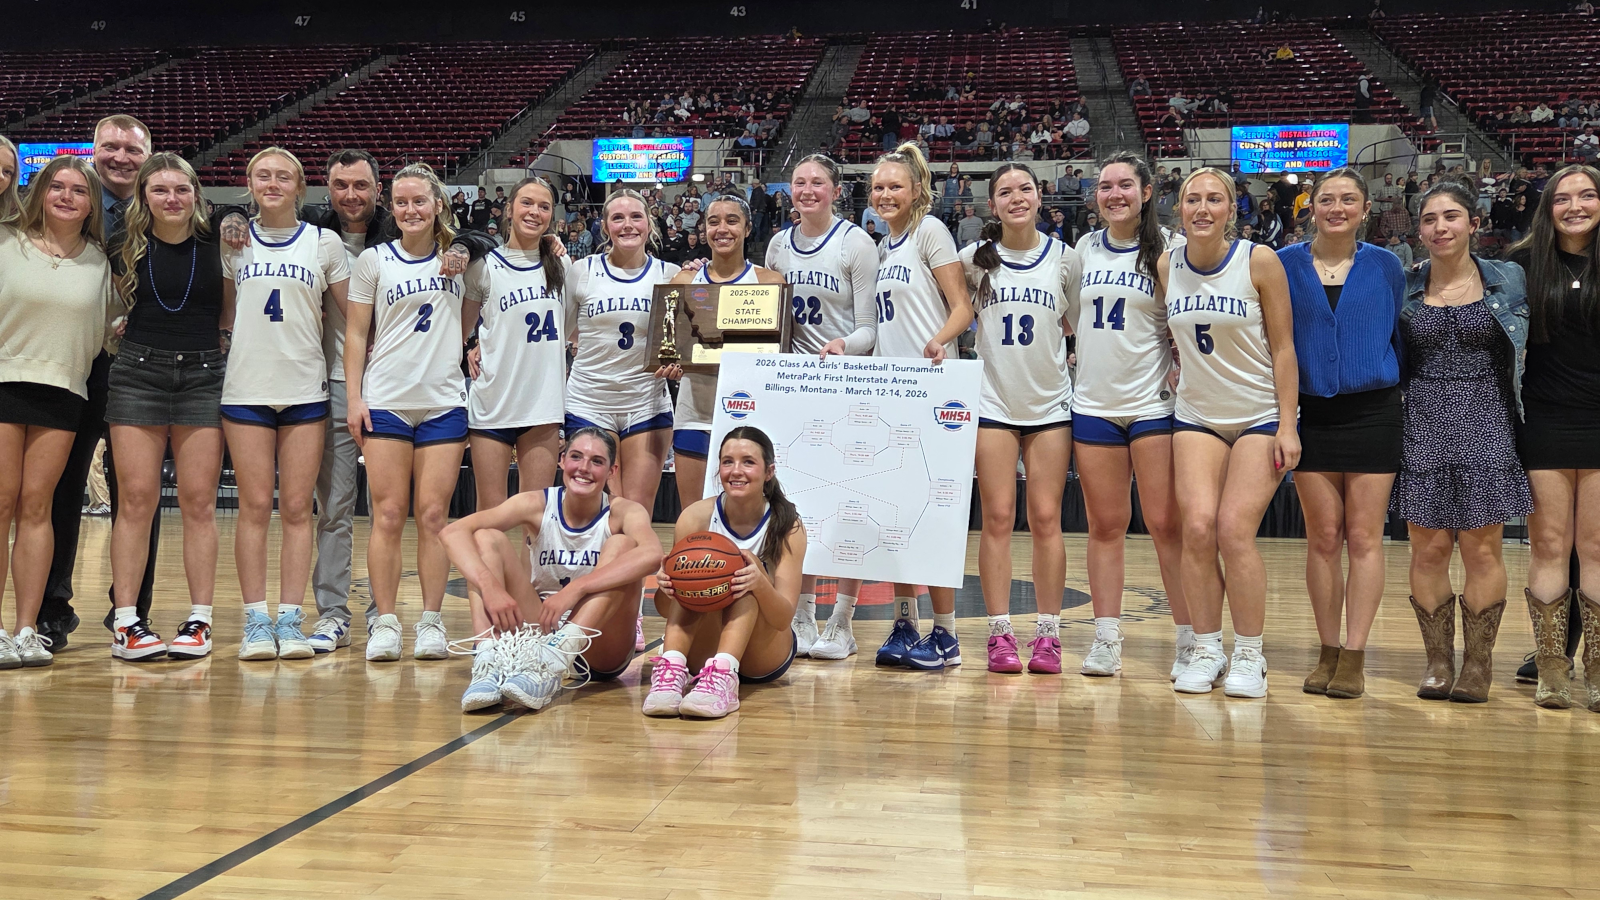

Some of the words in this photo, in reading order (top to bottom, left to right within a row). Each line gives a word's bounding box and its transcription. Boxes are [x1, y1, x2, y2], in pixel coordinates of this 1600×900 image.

[730, 6, 746, 16] 43
[961, 0, 977, 9] 41
[91, 20, 106, 30] 49
[294, 16, 311, 26] 47
[510, 11, 525, 22] 45
[1279, 130, 1338, 138] INSTALLATION,
[1297, 140, 1341, 148] PACKAGES,
[236, 262, 315, 289] GALLATIN
[386, 276, 461, 306] GALLATIN
[982, 287, 1055, 312] GALLATIN
[264, 289, 283, 322] 4
[587, 297, 651, 318] GALLAT
[792, 296, 822, 325] 22
[876, 289, 894, 323] 15
[1093, 296, 1126, 331] 14
[414, 303, 433, 332] 2
[525, 310, 558, 343] 24
[1002, 314, 1034, 346] 13
[618, 322, 635, 350] 3
[1195, 323, 1214, 355] 5
[755, 358, 776, 367] 2026
[779, 360, 800, 368] Class
[843, 362, 889, 371] Basketball
[891, 364, 944, 373] Tournament
[777, 372, 821, 381] MetraPark
[824, 374, 843, 382] First
[846, 375, 889, 384] Interstate
[891, 377, 918, 385] Arena
[765, 383, 797, 394] Billings,
[800, 385, 837, 394] Montana
[845, 387, 872, 395] March
[875, 388, 902, 398] 12-14,
[905, 390, 928, 398] 2026
[727, 400, 756, 411] MHSA
[939, 410, 971, 422] MHSA
[539, 549, 601, 566] GALLAT
[673, 554, 726, 571] Baden
[712, 582, 730, 596] PRO
